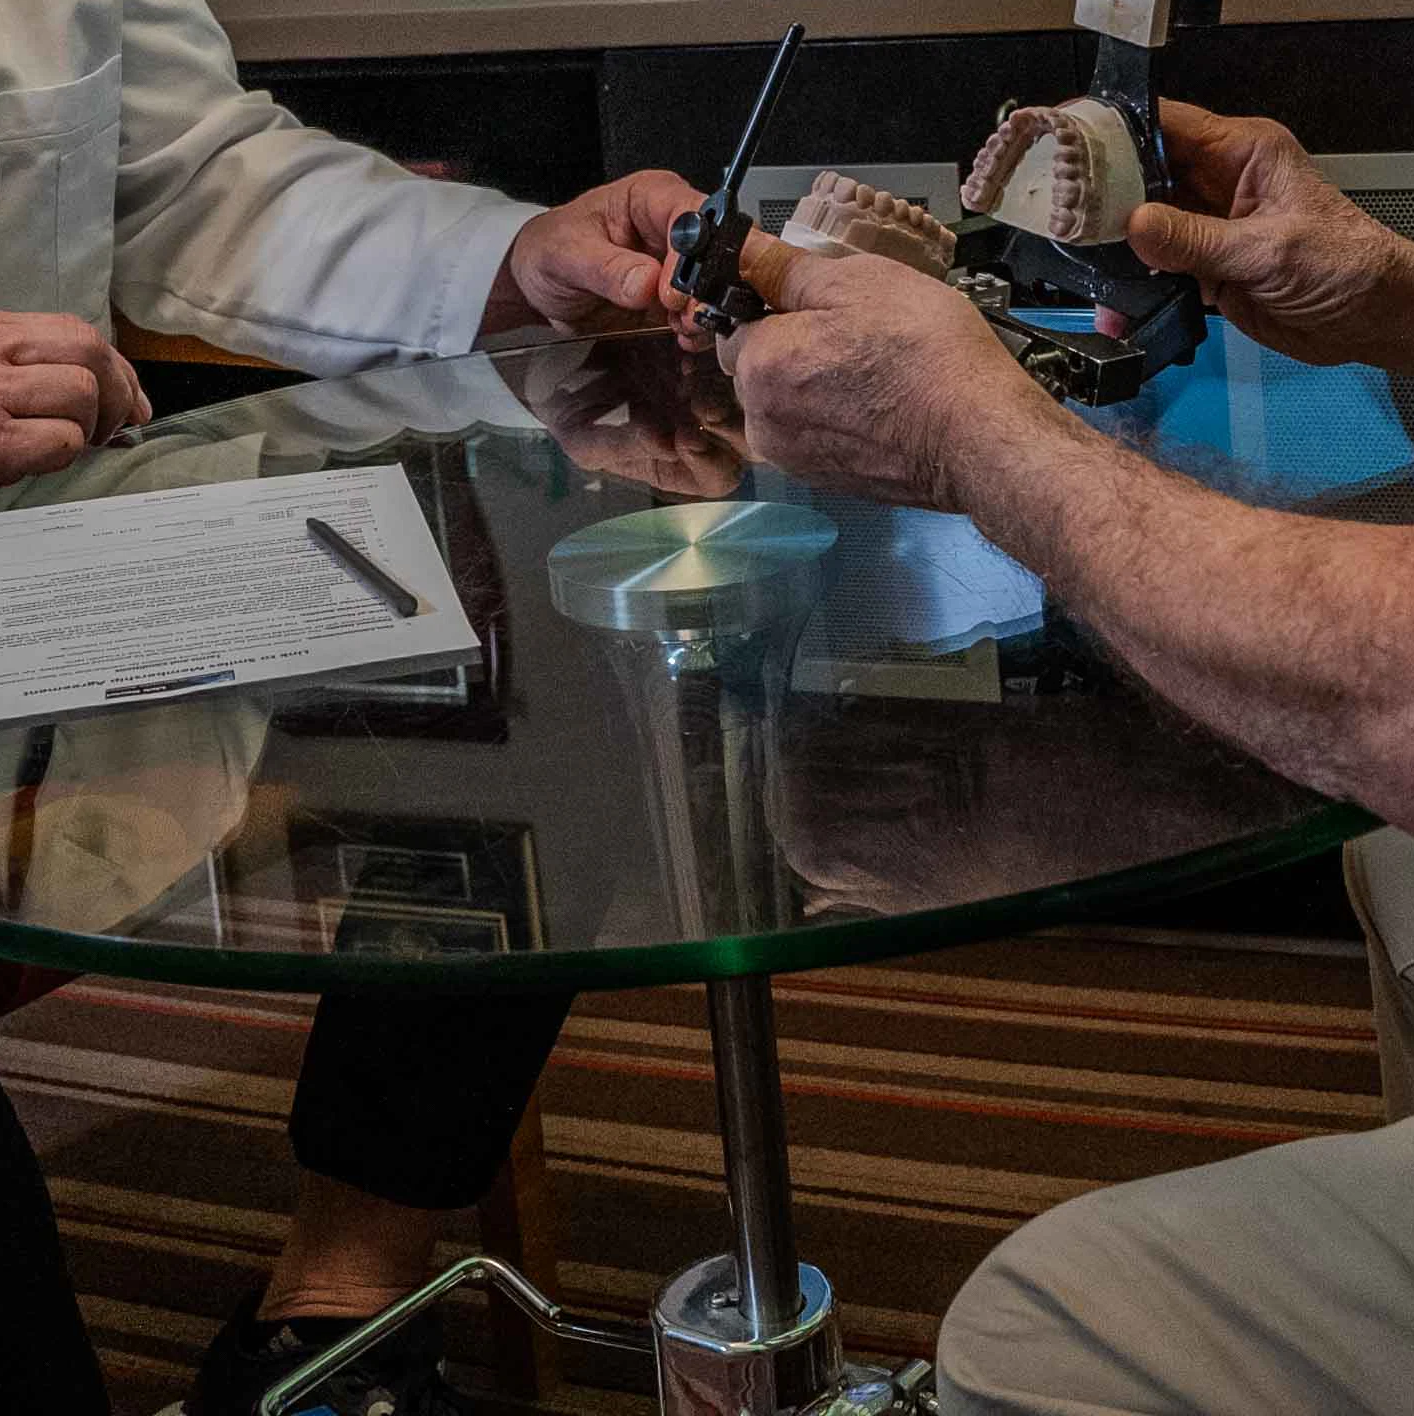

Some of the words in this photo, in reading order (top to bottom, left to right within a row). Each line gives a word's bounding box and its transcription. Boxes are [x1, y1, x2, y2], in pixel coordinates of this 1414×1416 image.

[278, 648, 310, 658] Link
[108, 664, 205, 684] Membership
[21, 678, 106, 697] Agreement
